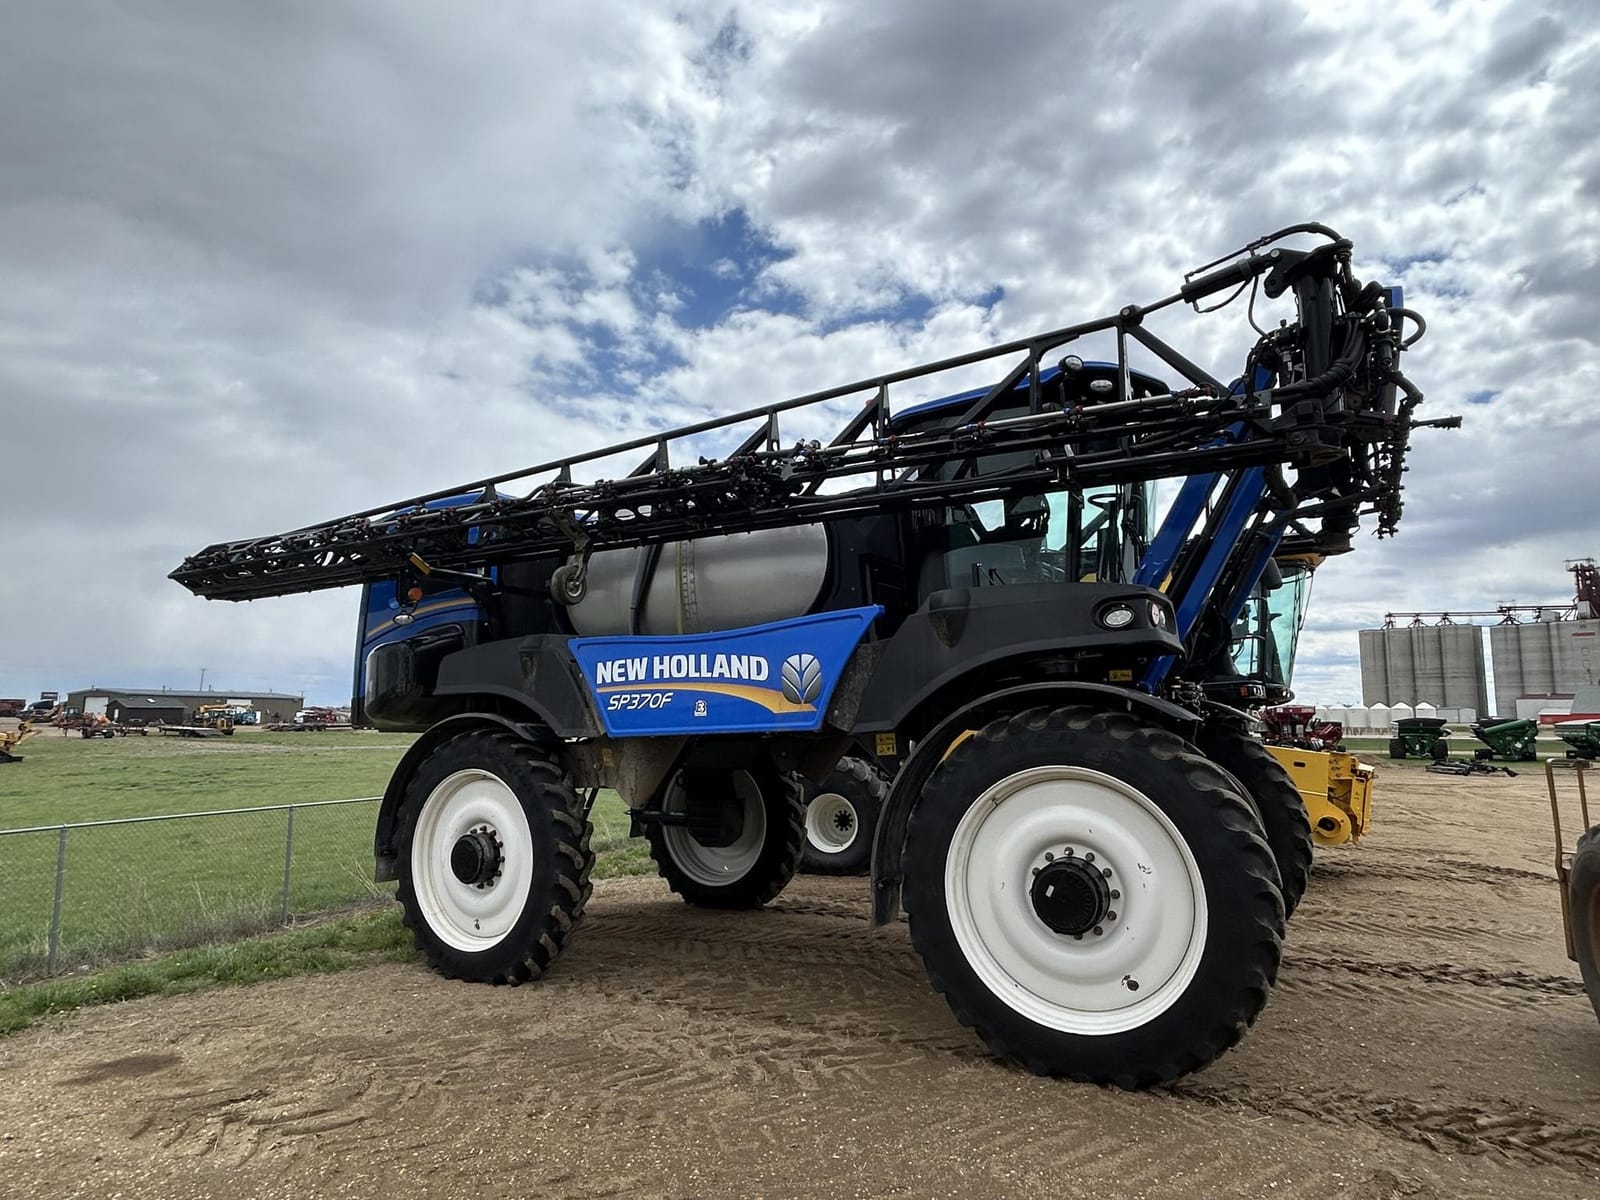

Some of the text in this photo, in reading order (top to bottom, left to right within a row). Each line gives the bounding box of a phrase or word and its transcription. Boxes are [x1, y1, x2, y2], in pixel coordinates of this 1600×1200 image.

[596, 653, 769, 684] NEW HOLLAND
[607, 692, 674, 711] SP370F
